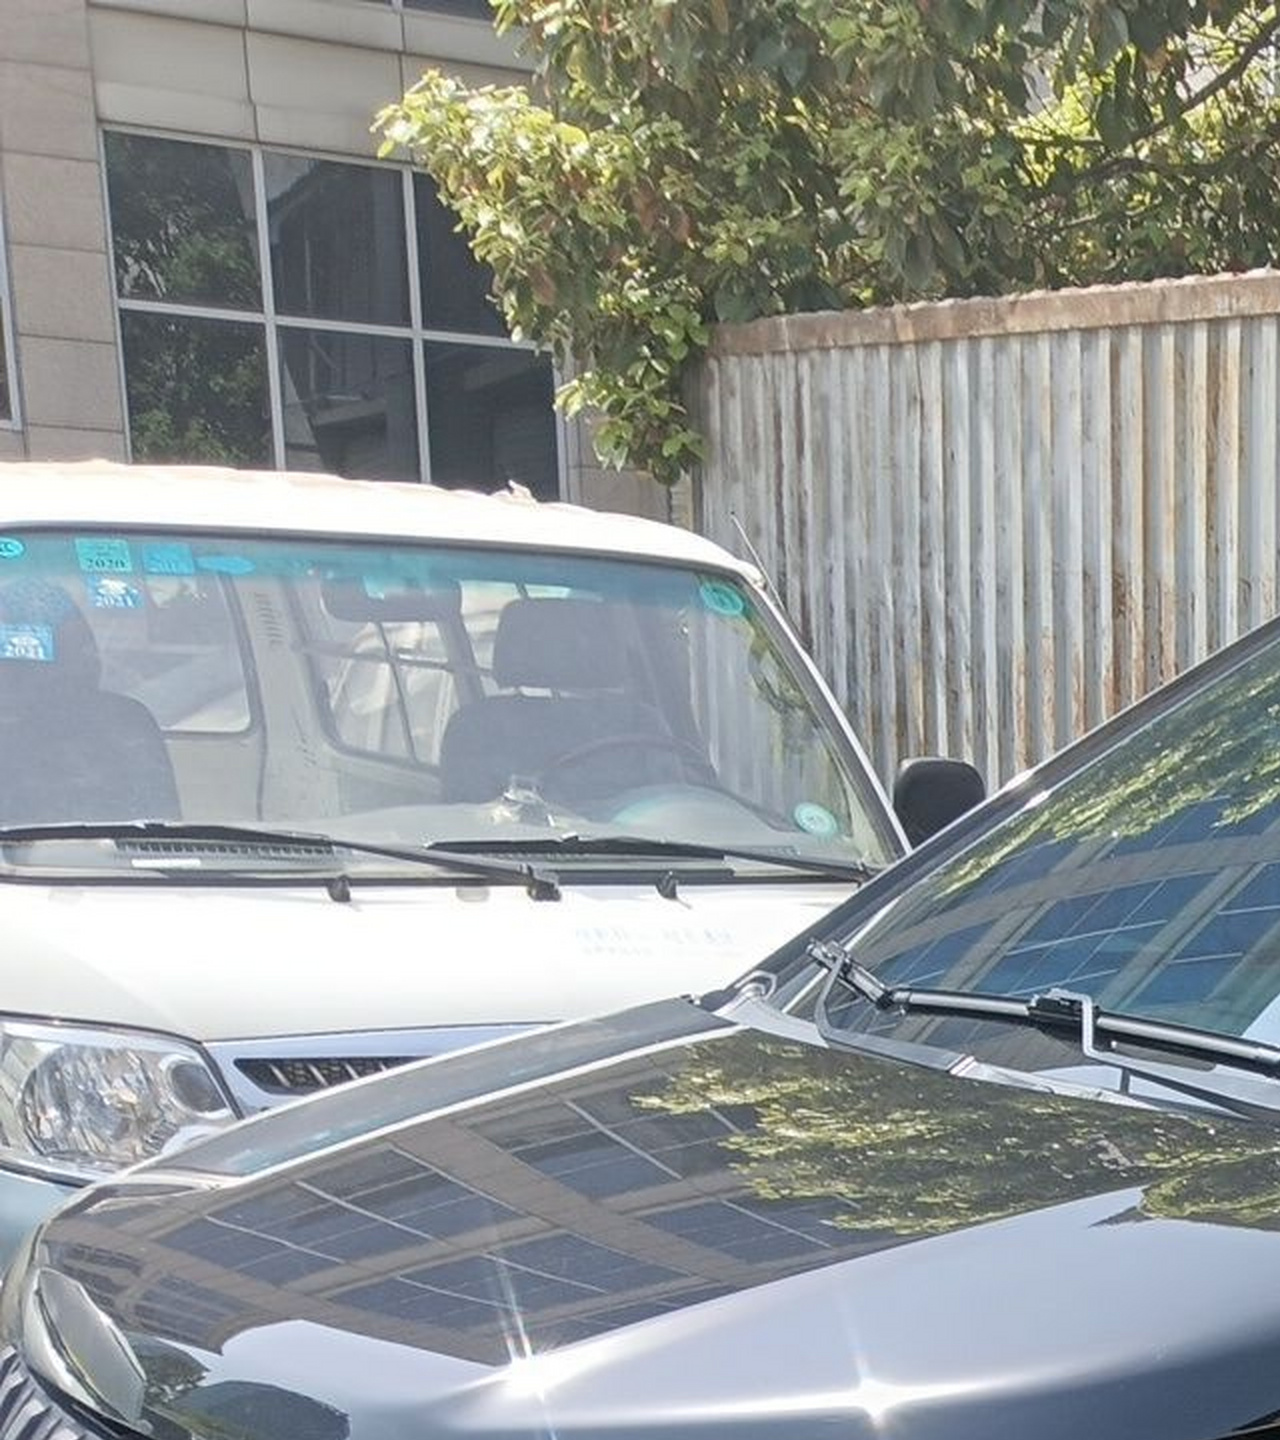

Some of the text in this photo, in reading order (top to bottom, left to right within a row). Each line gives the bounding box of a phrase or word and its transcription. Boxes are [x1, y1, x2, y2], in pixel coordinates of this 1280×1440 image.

[87, 557, 126, 569] 2020
[95, 595, 136, 608] 2021
[4, 645, 45, 659] 2021
